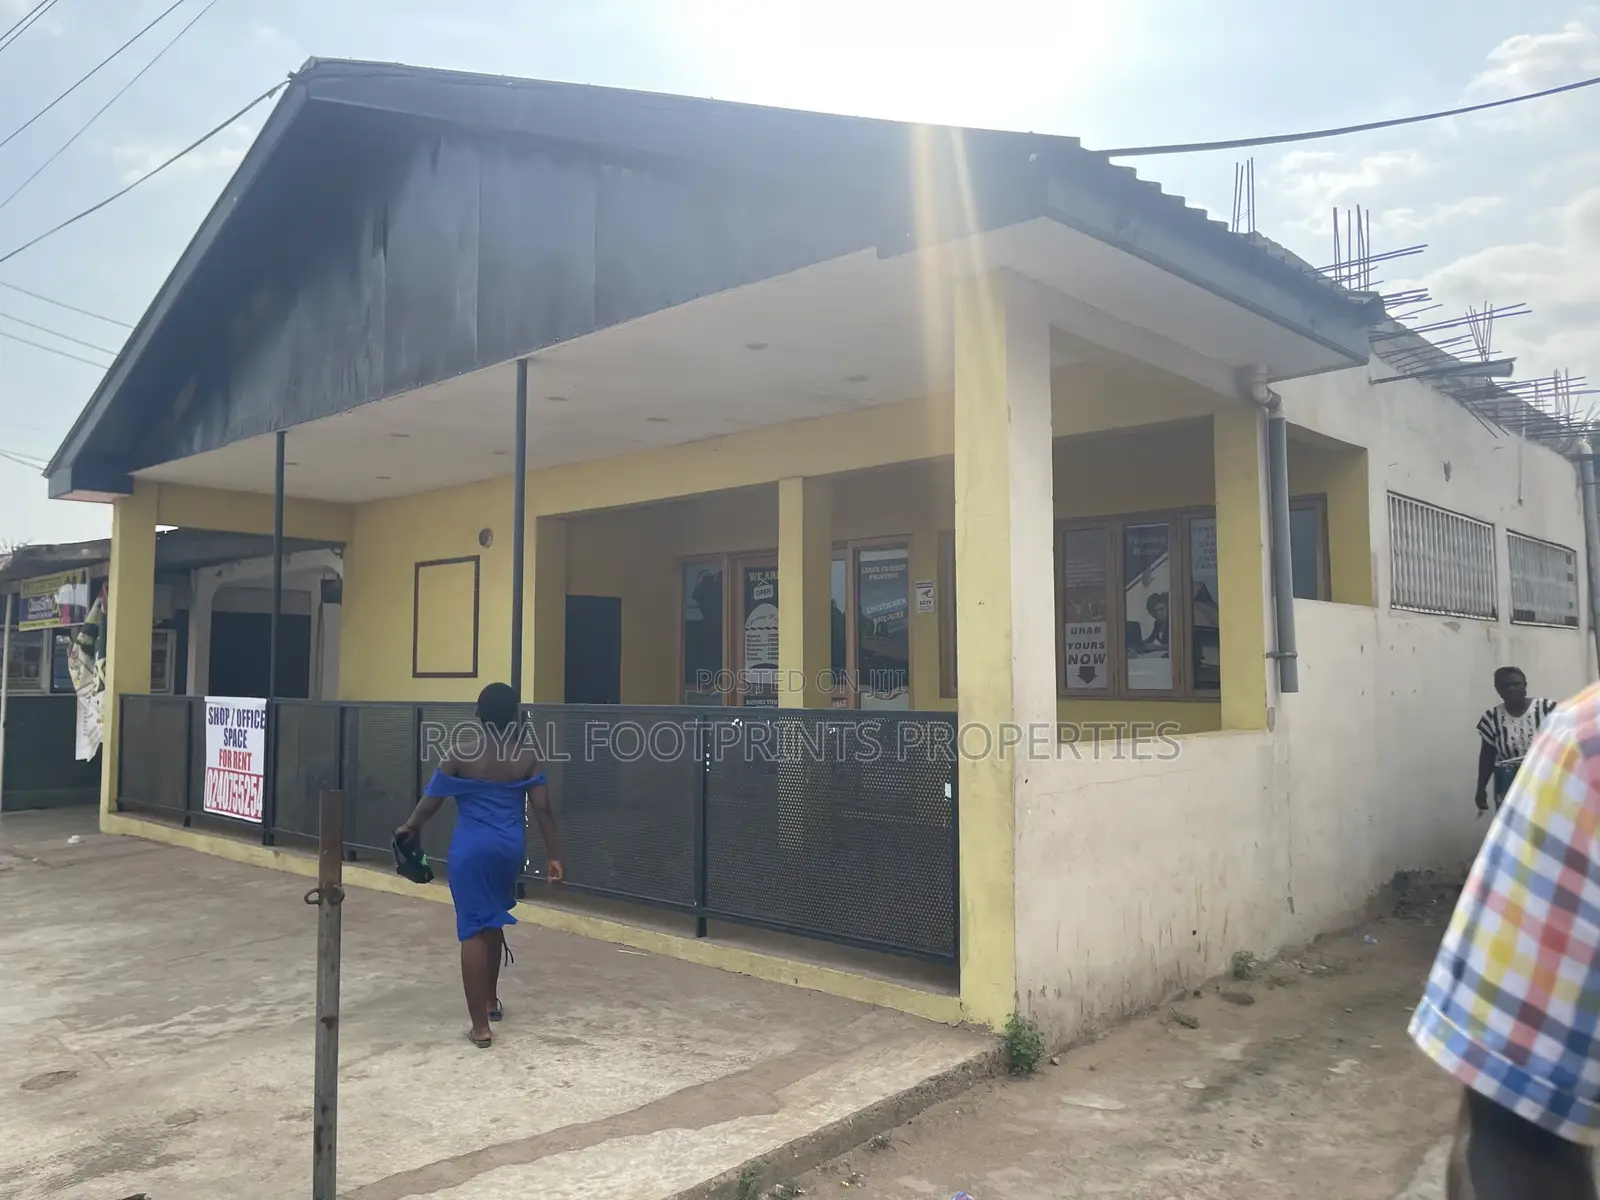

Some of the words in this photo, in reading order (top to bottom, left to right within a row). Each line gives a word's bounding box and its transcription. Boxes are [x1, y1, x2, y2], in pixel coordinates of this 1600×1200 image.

[749, 572, 764, 581] WE
[765, 571, 778, 580] AR
[755, 588, 772, 597] OPEN
[1071, 626, 1102, 635] GRAB
[1067, 641, 1106, 650] YOURS
[1067, 653, 1107, 665] NOW
[208, 706, 230, 726] SHOP
[236, 709, 266, 730] OFFICE
[223, 727, 248, 749] SPACE
[218, 748, 233, 768] FOR
[233, 751, 252, 771] RENT
